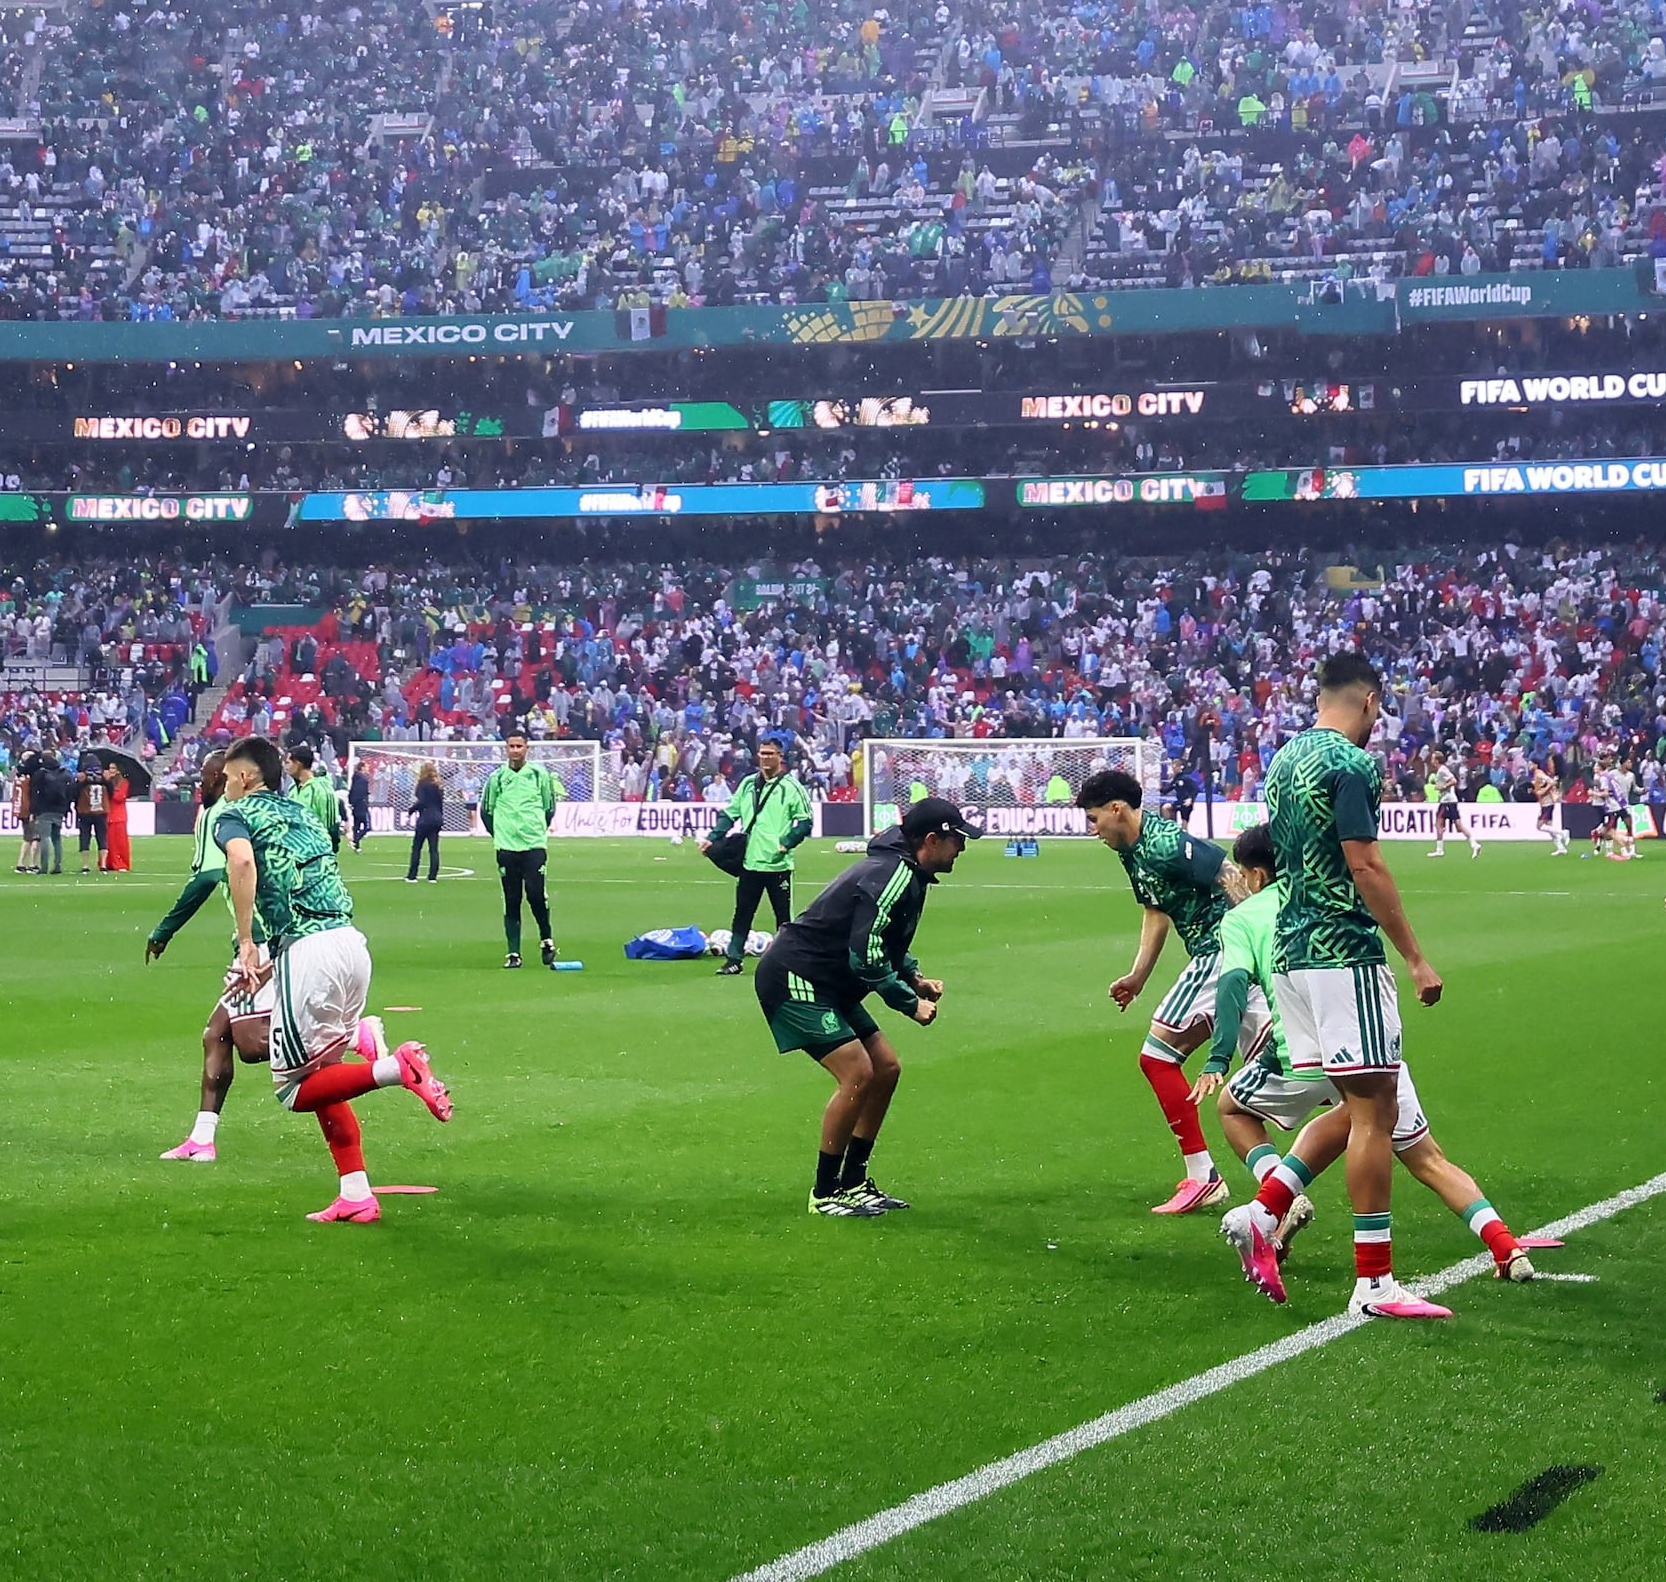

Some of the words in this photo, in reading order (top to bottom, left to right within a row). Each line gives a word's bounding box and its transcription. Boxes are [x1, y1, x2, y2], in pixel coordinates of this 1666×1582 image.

[1408, 282, 1532, 309] #FIFAWorldCup
[351, 322, 487, 346] MEXICO
[494, 320, 575, 342] CITY
[1460, 380, 1522, 405] FIFA
[1524, 375, 1626, 401] WORLD
[1020, 394, 1132, 418] MEXICO
[1137, 391, 1205, 416] CITY
[74, 416, 182, 440] MEXICO
[186, 416, 251, 439] CITY
[1023, 479, 1133, 503] MEXICO
[1463, 467, 1525, 492] FIFA
[1527, 464, 1630, 490] WORLD
[72, 496, 180, 520] MEXICO
[184, 496, 251, 520] CITY
[564, 803, 608, 833] Unite
[611, 805, 635, 832] For
[637, 807, 719, 831] EDUCATIO
[986, 807, 1087, 834] EDUCATION
[1470, 814, 1513, 830] FIFA
